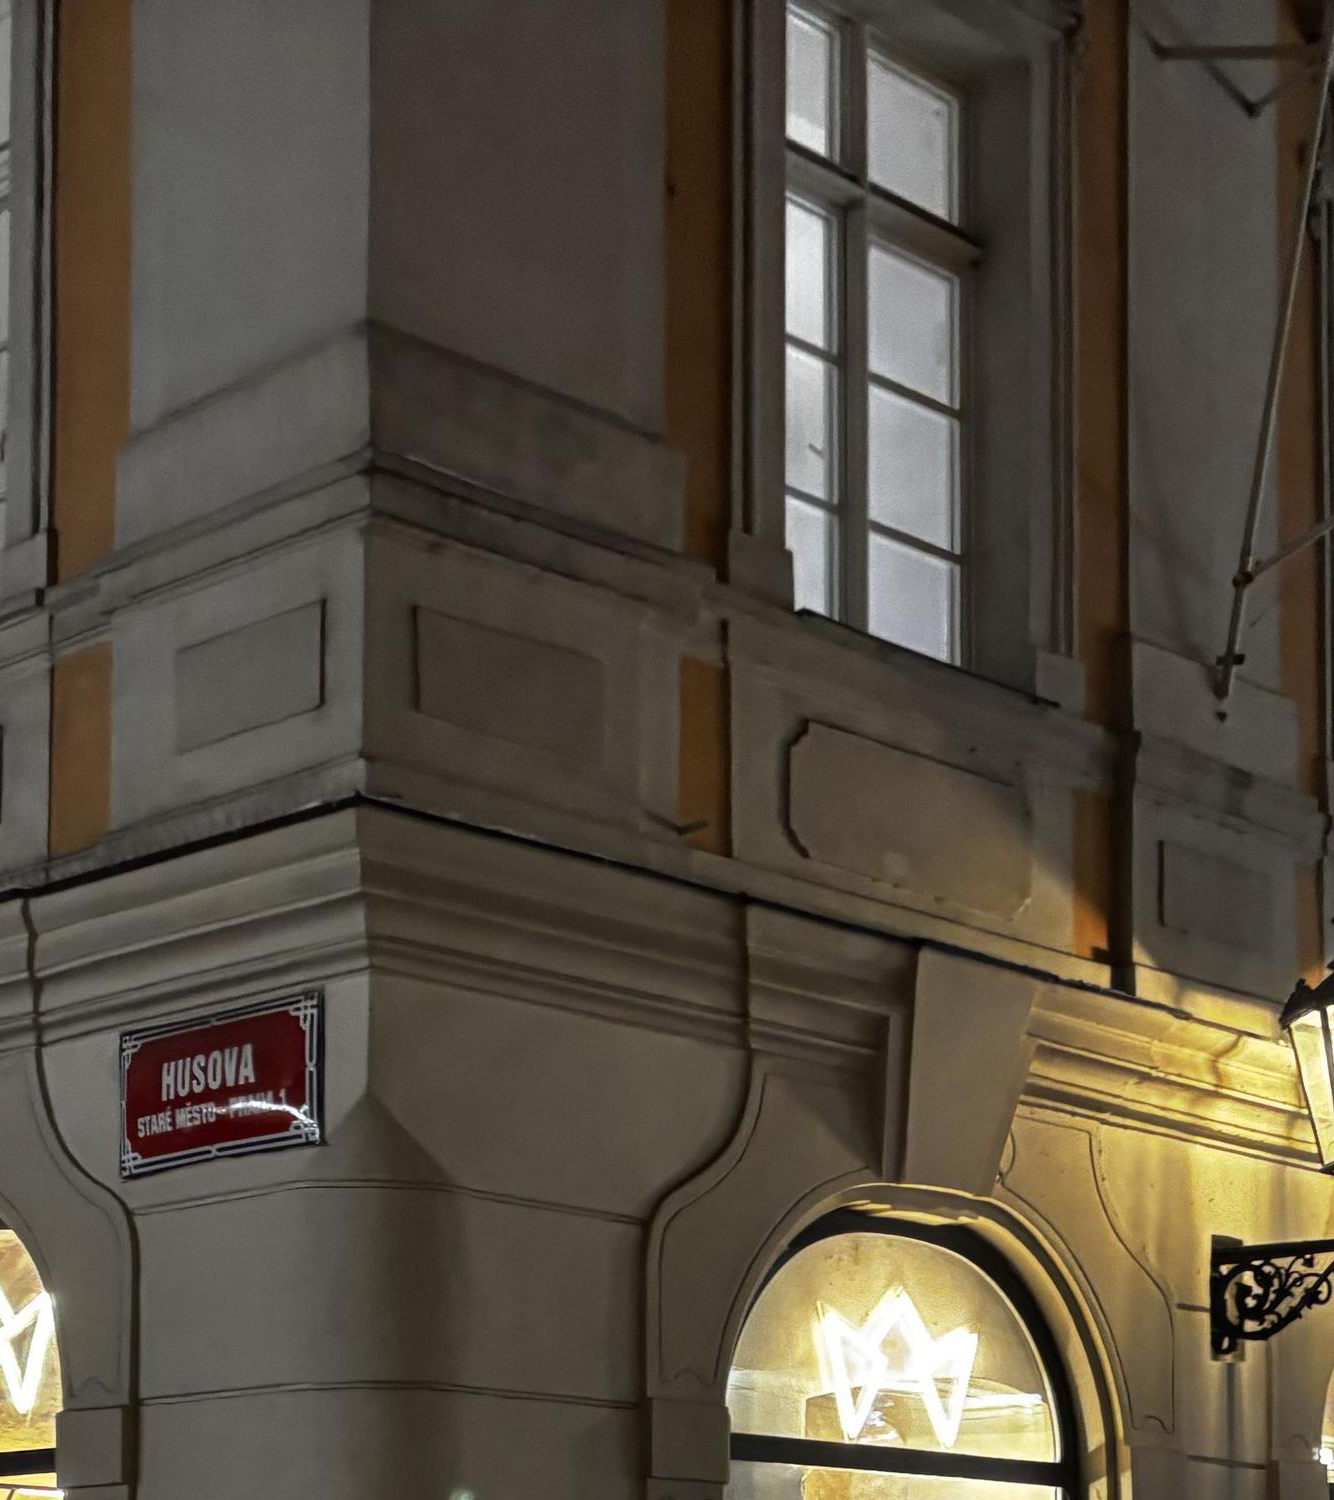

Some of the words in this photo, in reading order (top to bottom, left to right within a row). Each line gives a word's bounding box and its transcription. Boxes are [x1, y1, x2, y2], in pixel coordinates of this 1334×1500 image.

[161, 1044, 256, 1101] HUSOVA
[137, 1106, 173, 1138] STARÉ
[174, 1101, 217, 1129] MĚSTO
